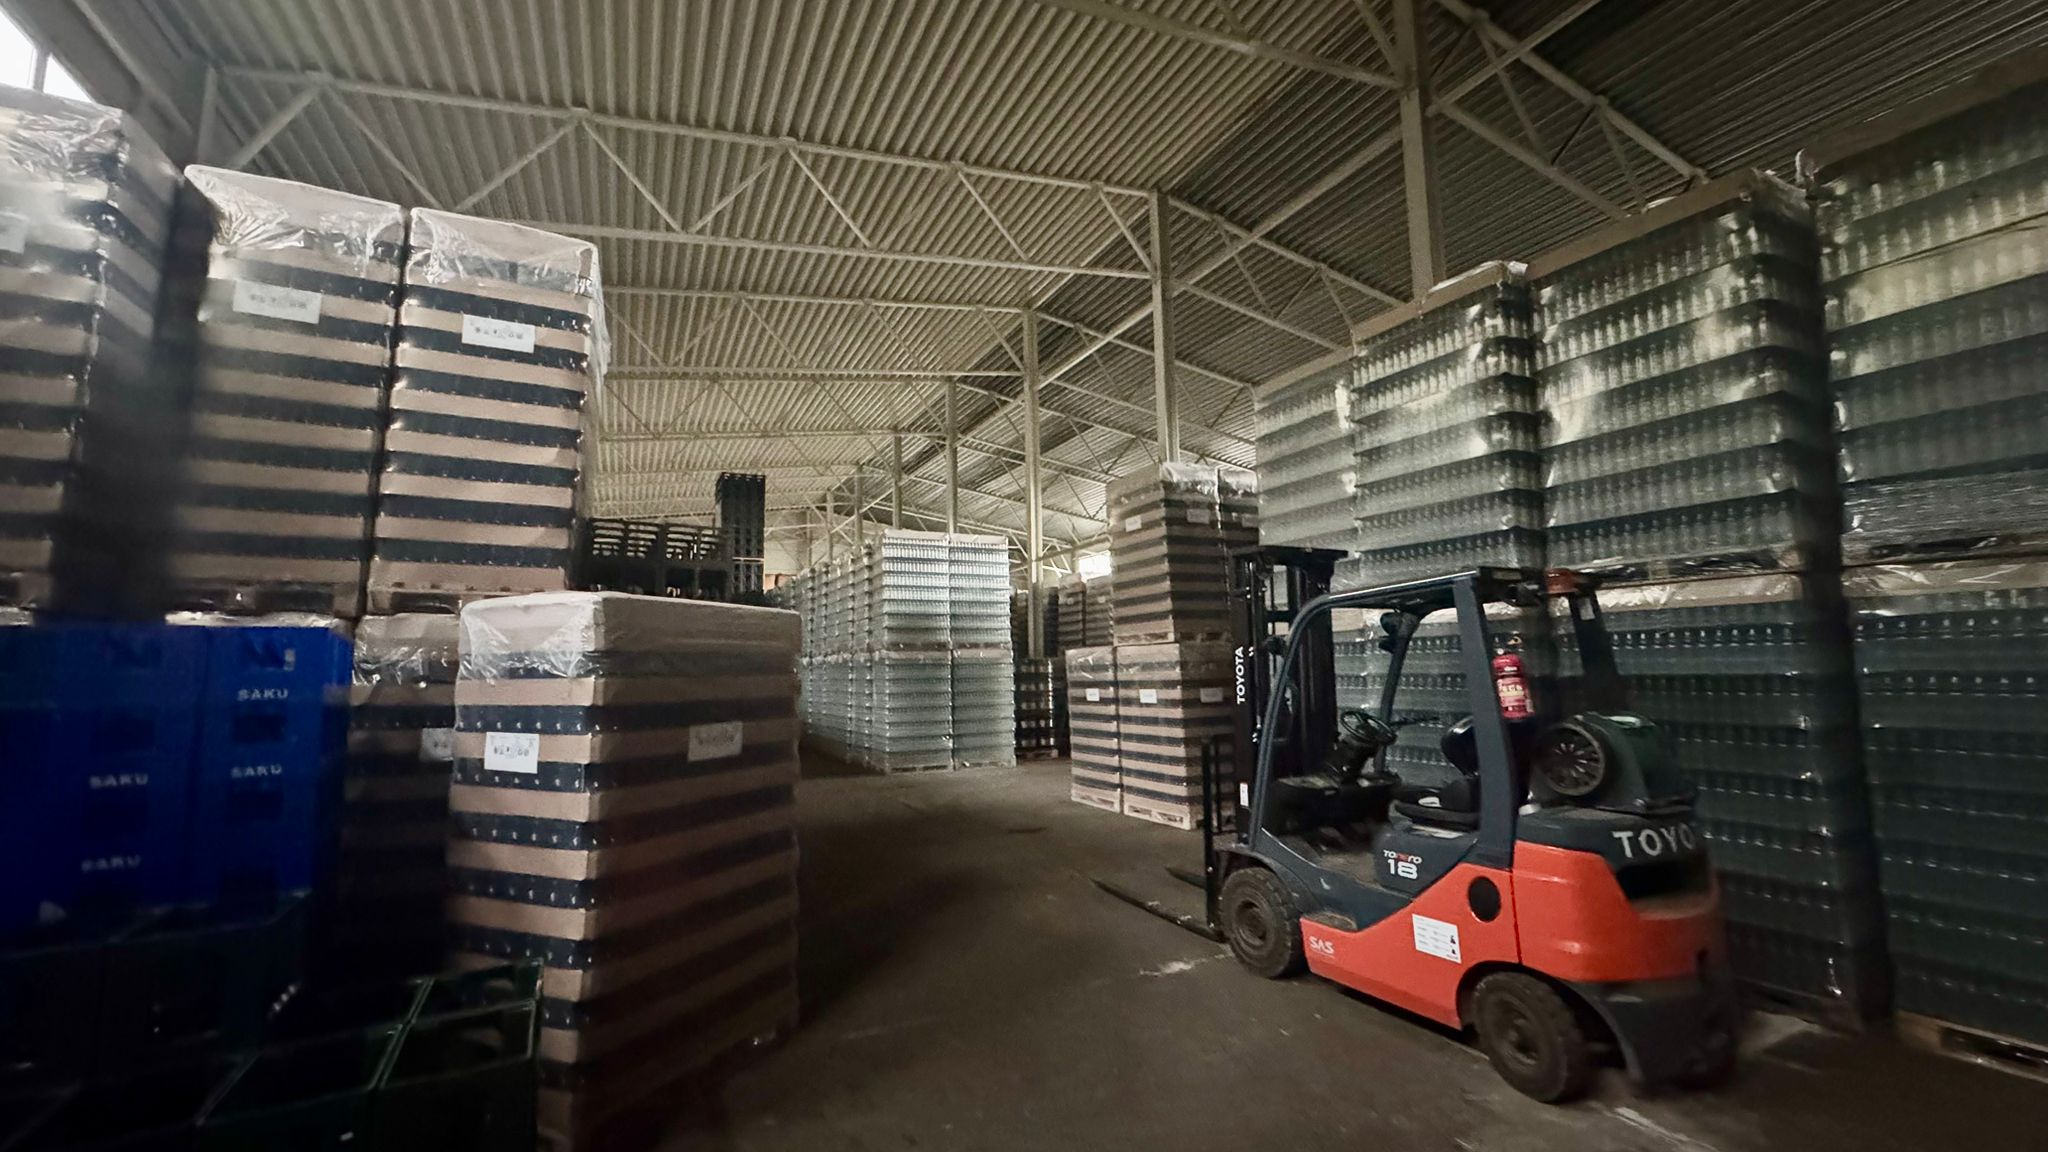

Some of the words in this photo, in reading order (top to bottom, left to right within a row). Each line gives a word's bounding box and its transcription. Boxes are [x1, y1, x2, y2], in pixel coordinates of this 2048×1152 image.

[1234, 646, 1246, 705] TOYOTA
[237, 688, 289, 701] SAKU
[1612, 823, 1695, 858] TOYO
[1387, 858, 1418, 880] 18
[1309, 935, 1335, 955] SAS
